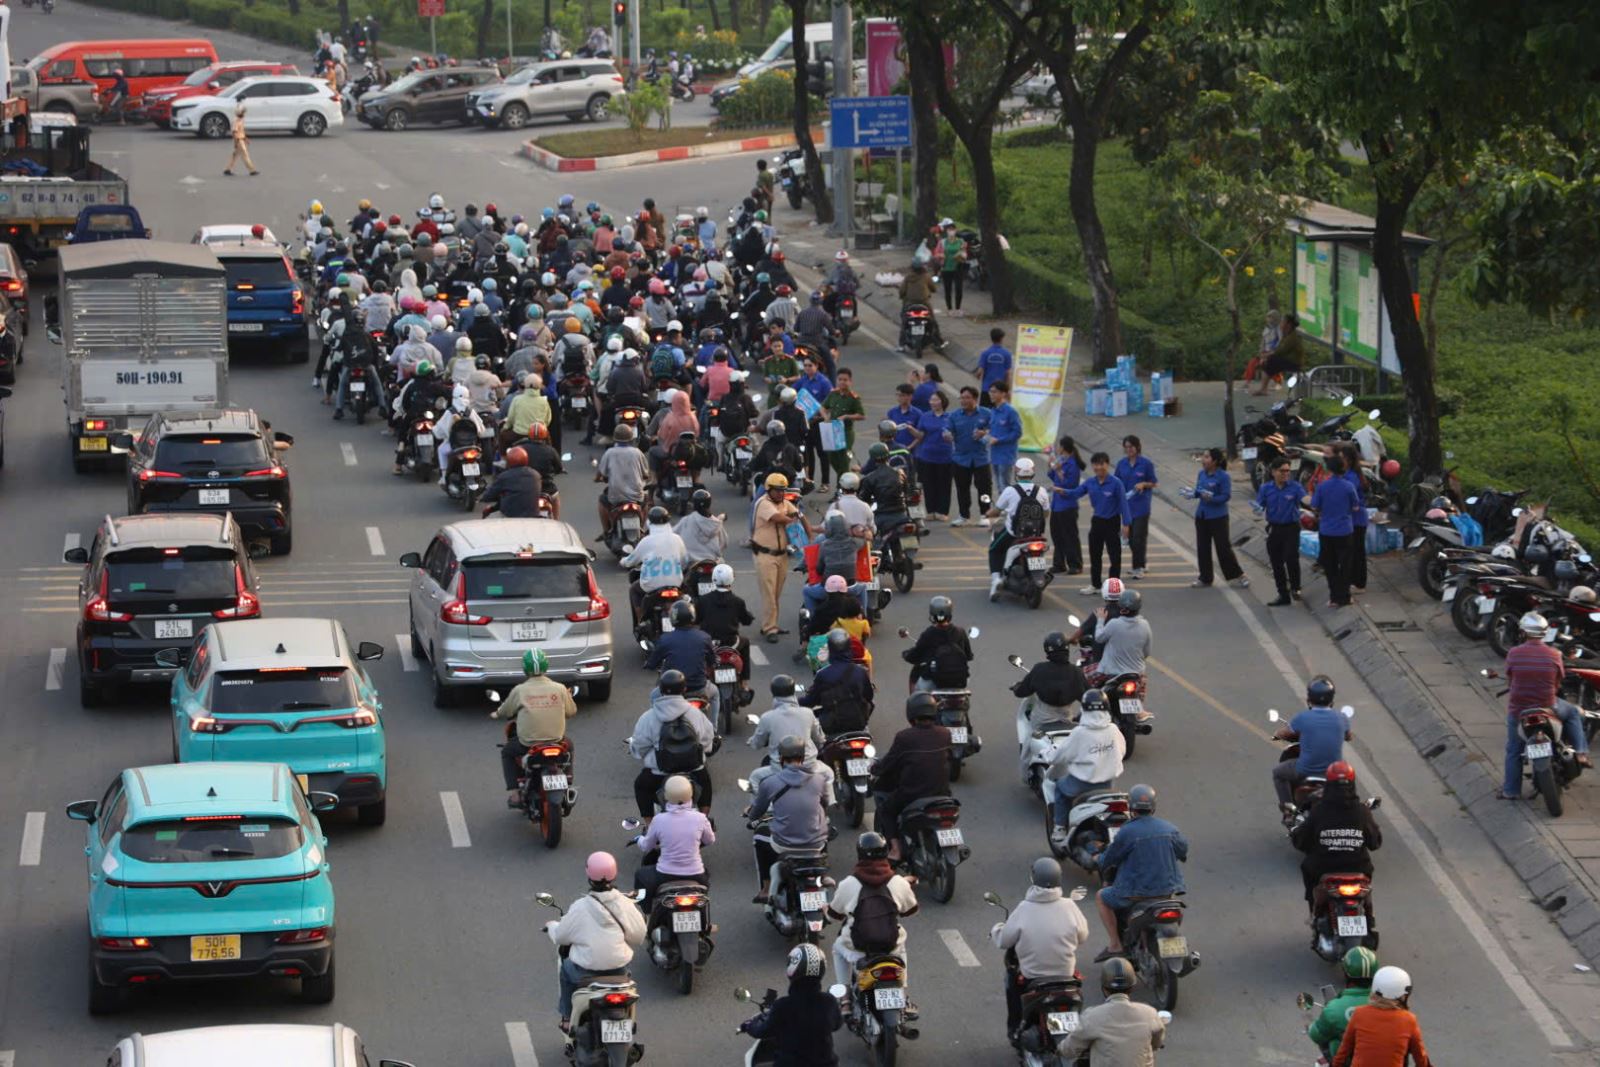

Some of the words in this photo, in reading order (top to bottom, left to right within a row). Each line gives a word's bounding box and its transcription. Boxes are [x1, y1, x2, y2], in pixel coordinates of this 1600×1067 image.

[116, 371, 183, 385] 50H-190.91
[205, 937, 227, 948] 50H
[197, 947, 236, 959] 776.56
[606, 1021, 628, 1031] 77-AE
[603, 1031, 631, 1042] 071.29
